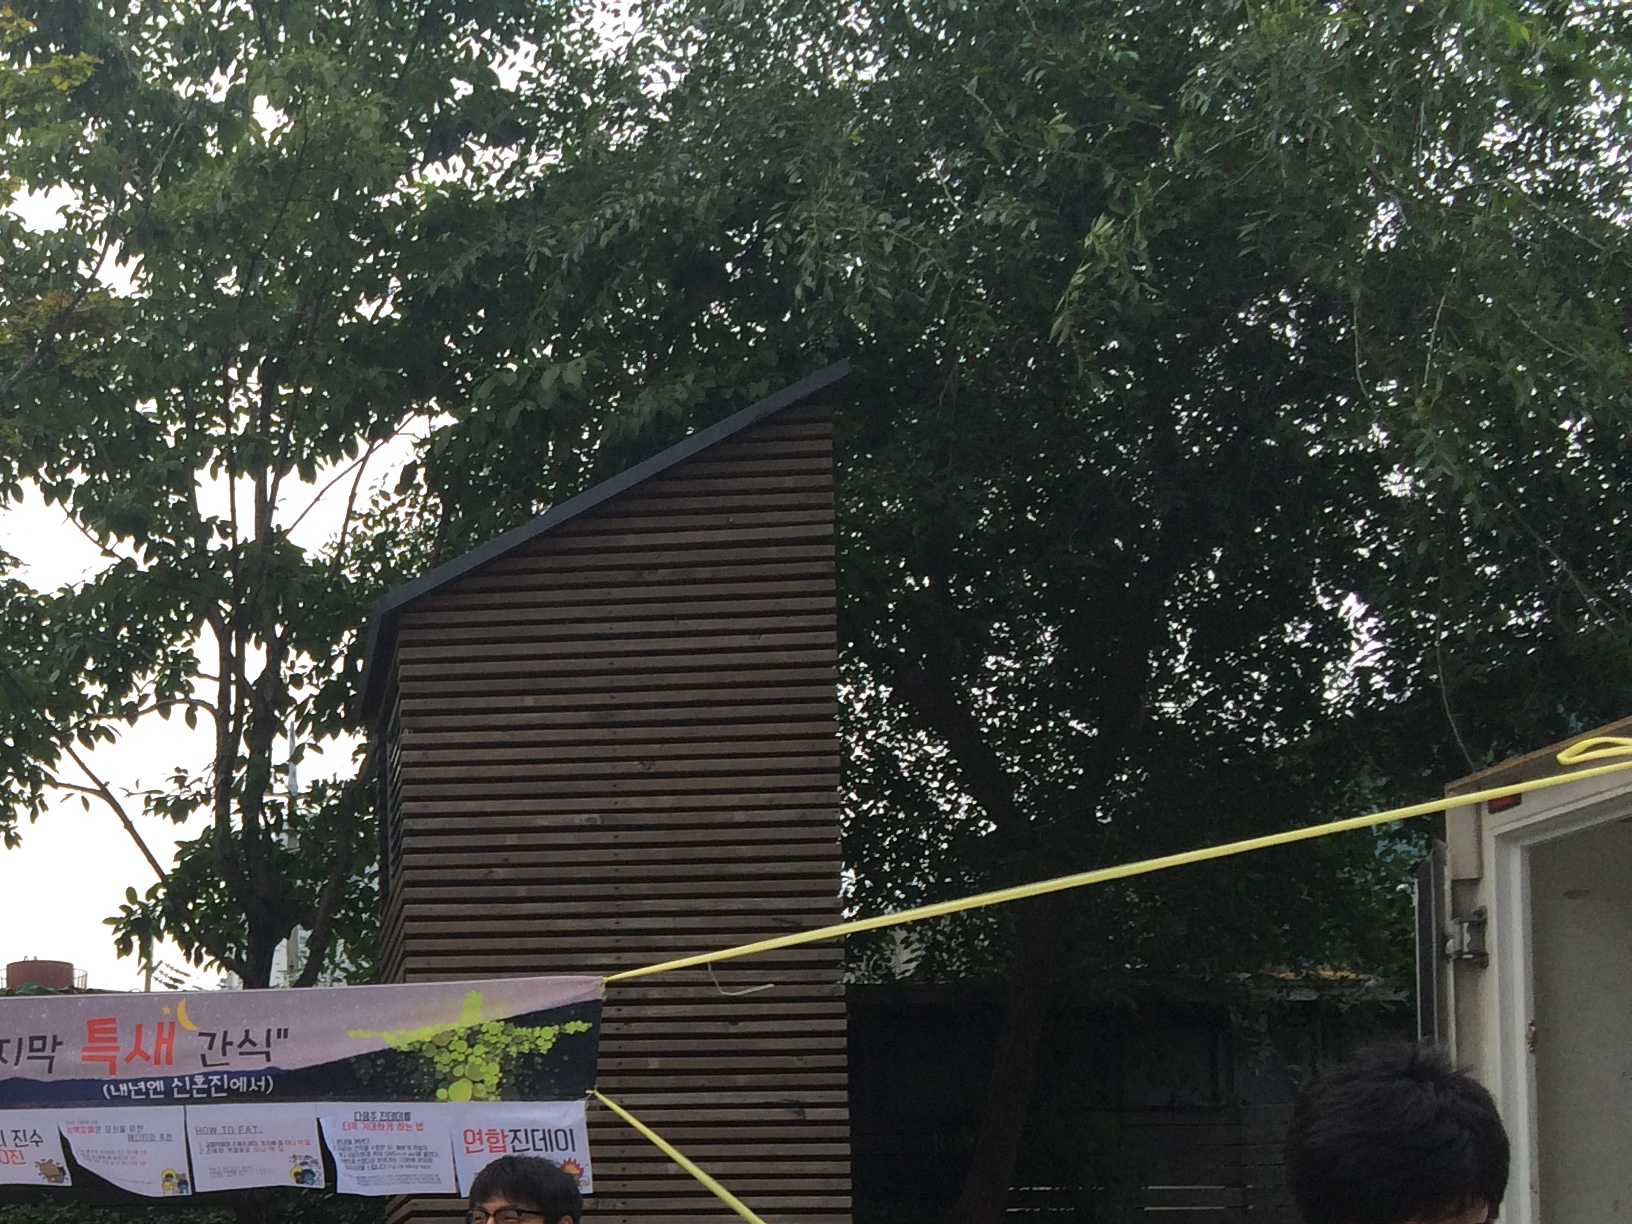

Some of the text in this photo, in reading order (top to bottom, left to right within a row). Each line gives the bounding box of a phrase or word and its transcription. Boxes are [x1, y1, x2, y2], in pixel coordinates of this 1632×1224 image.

[81, 1017, 176, 1075] 특새
[102, 1080, 165, 1100] (내년엔
[11, 1129, 44, 1148] 진수
[463, 1128, 576, 1154] 연합진데이
